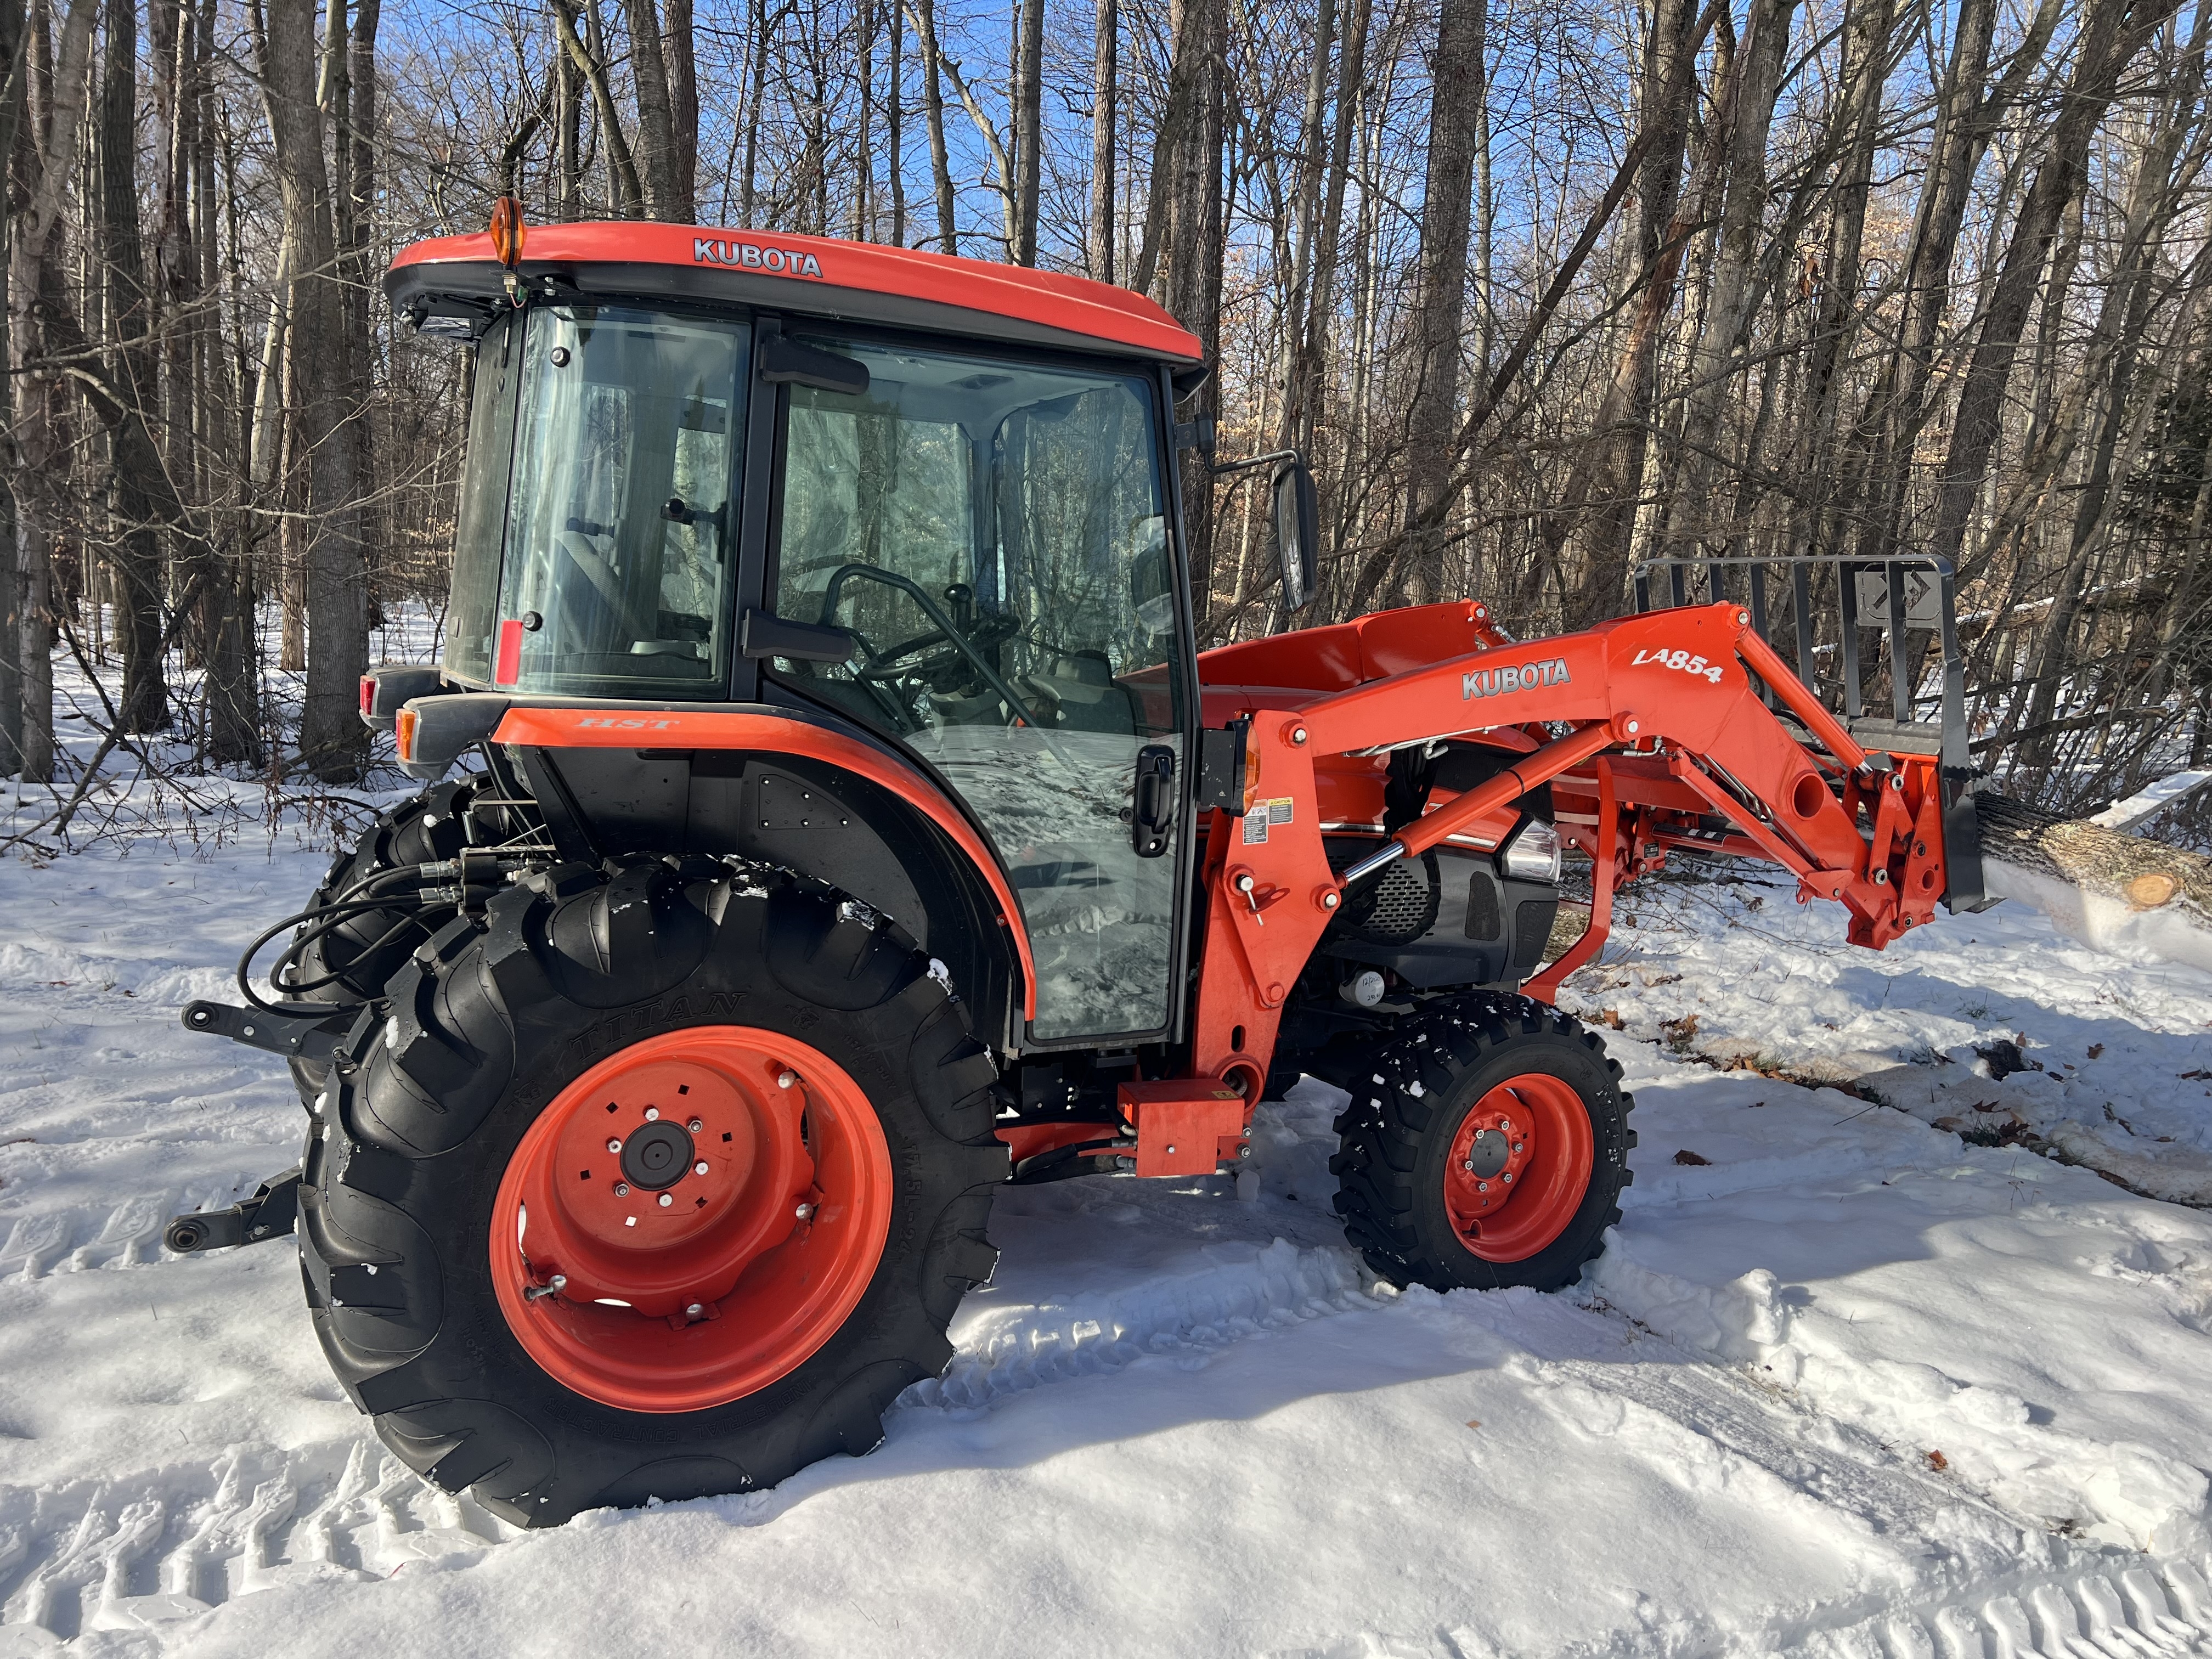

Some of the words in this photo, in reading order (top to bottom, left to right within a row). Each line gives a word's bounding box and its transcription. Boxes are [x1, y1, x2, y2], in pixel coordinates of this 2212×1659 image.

[693, 238, 823, 278] KUBOTA
[1462, 658, 1571, 700] KUBOTA
[1631, 648, 1724, 684] LA854
[574, 718, 680, 729] HST
[569, 992, 747, 1062] TITAN
[1595, 1085, 1618, 1164] TITAN
[895, 1144, 922, 1254] 17.5L-24
[544, 1396, 680, 1444] CONTRACTOR
[692, 1381, 814, 1440] INDUSTRIAL
